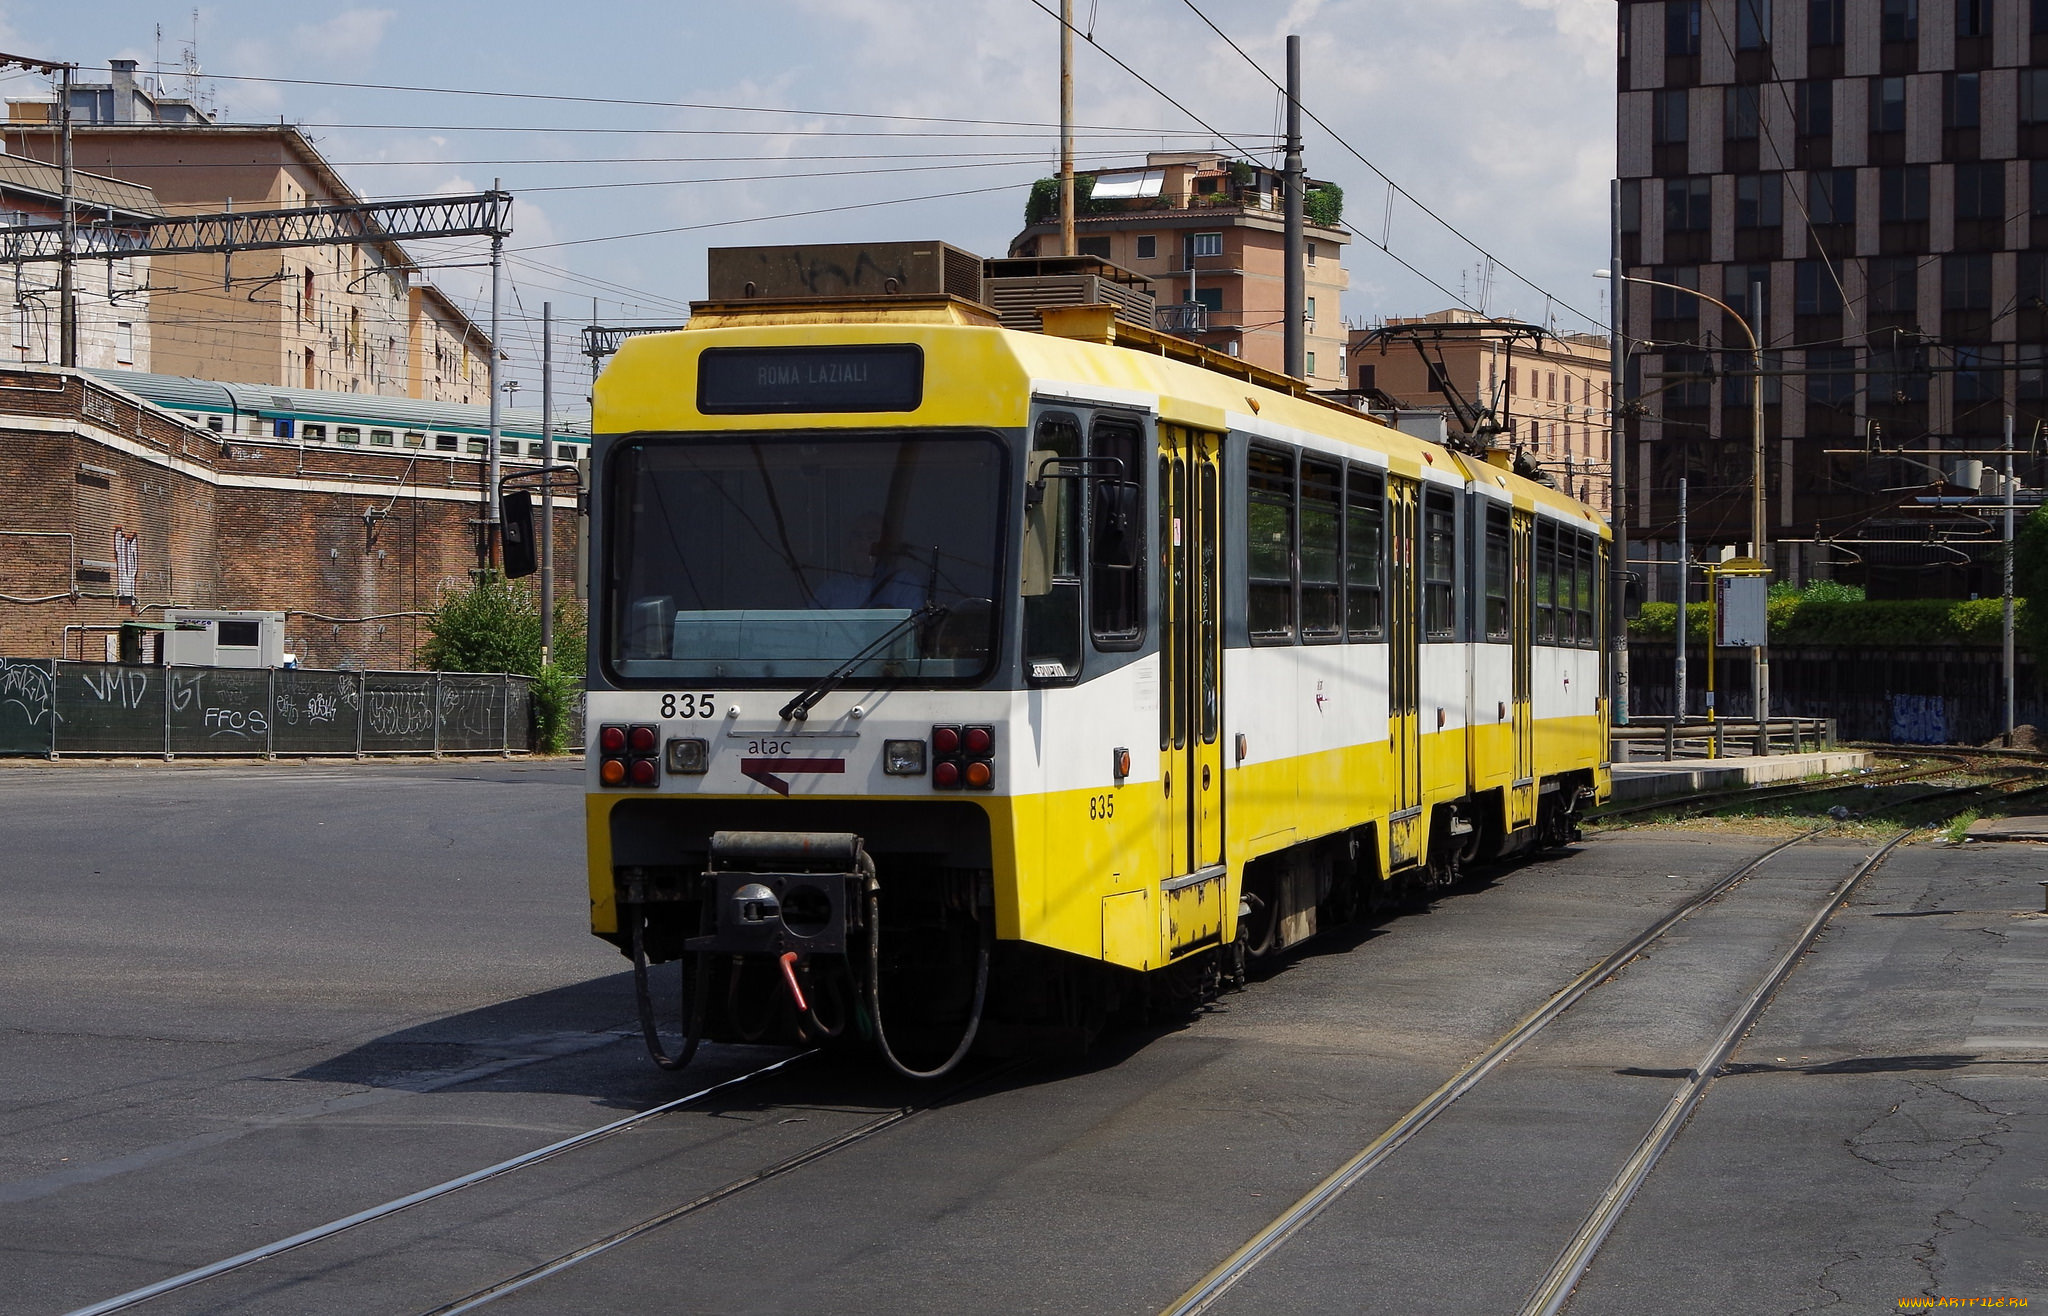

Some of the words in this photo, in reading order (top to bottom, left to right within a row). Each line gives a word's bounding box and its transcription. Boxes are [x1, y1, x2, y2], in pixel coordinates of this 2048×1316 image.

[758, 365, 800, 385] ROMA
[808, 363, 868, 384] LAZIALI
[660, 693, 715, 719] 835
[748, 737, 792, 755] atac
[1090, 793, 1114, 820] 835
